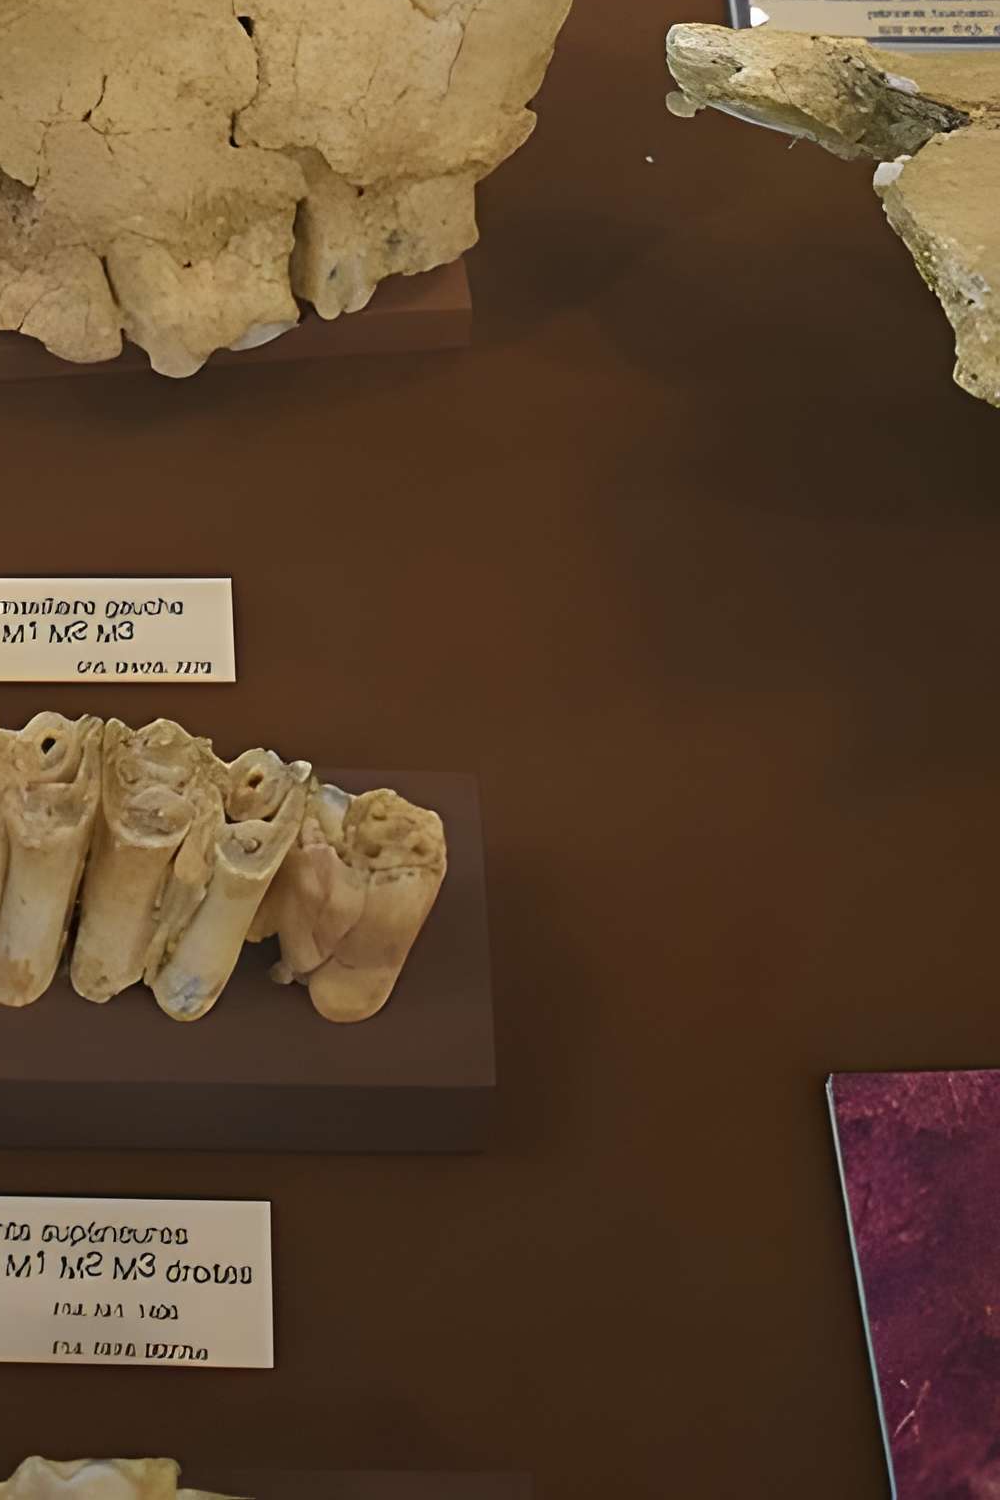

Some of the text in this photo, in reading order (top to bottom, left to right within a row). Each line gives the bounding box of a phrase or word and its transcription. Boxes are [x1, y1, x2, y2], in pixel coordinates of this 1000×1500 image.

[1, 621, 37, 643] M1
[97, 620, 134, 643] M3
[5, 1250, 45, 1278] M1
[113, 1252, 156, 1280] M3
